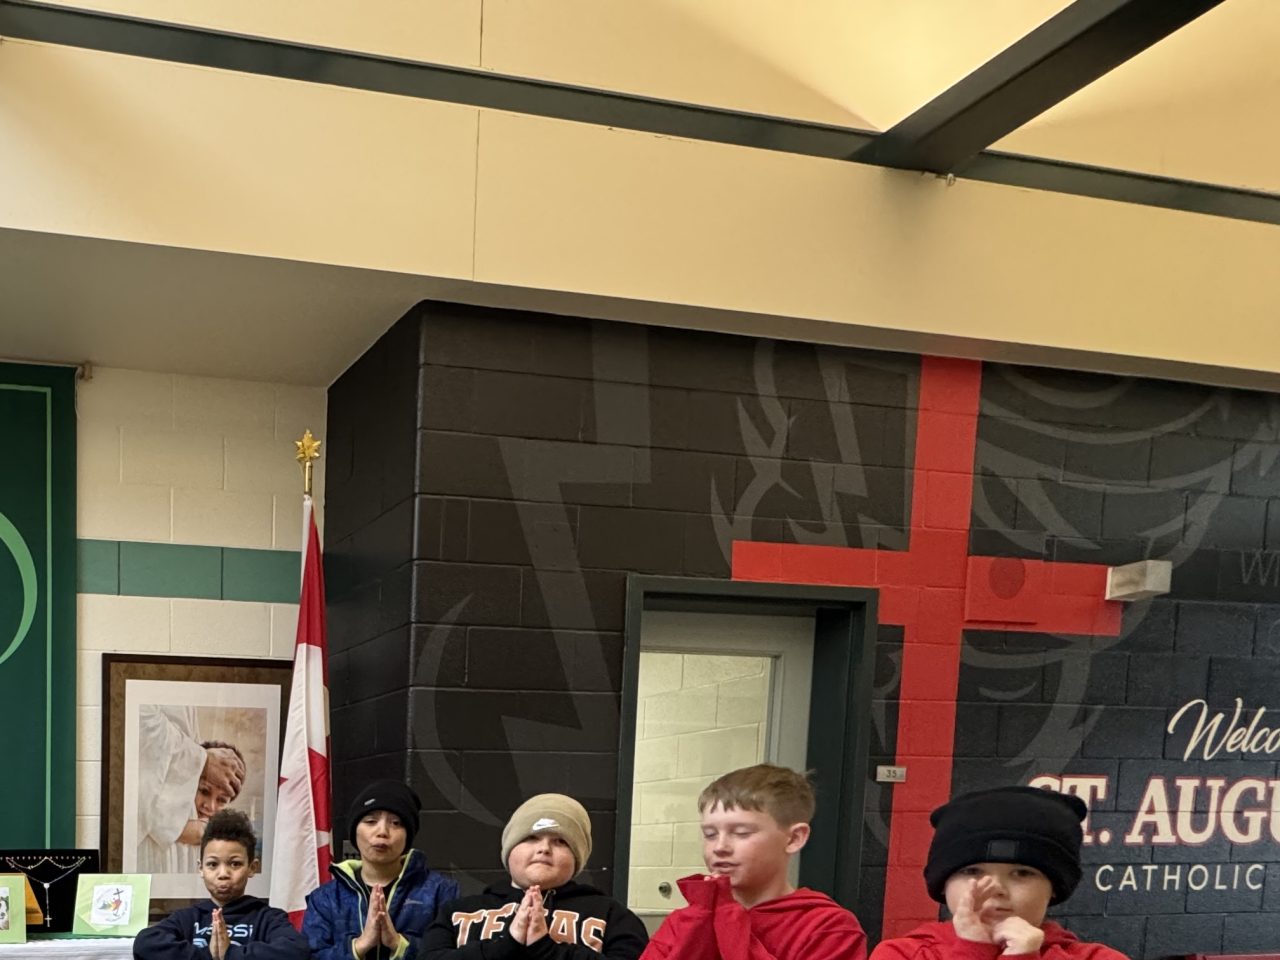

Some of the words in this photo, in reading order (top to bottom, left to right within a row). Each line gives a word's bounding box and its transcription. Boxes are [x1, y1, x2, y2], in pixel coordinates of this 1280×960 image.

[1124, 774, 1280, 847] AUG
[1095, 863, 1266, 892] CATHOLIC
[451, 902, 607, 954] TEAS
